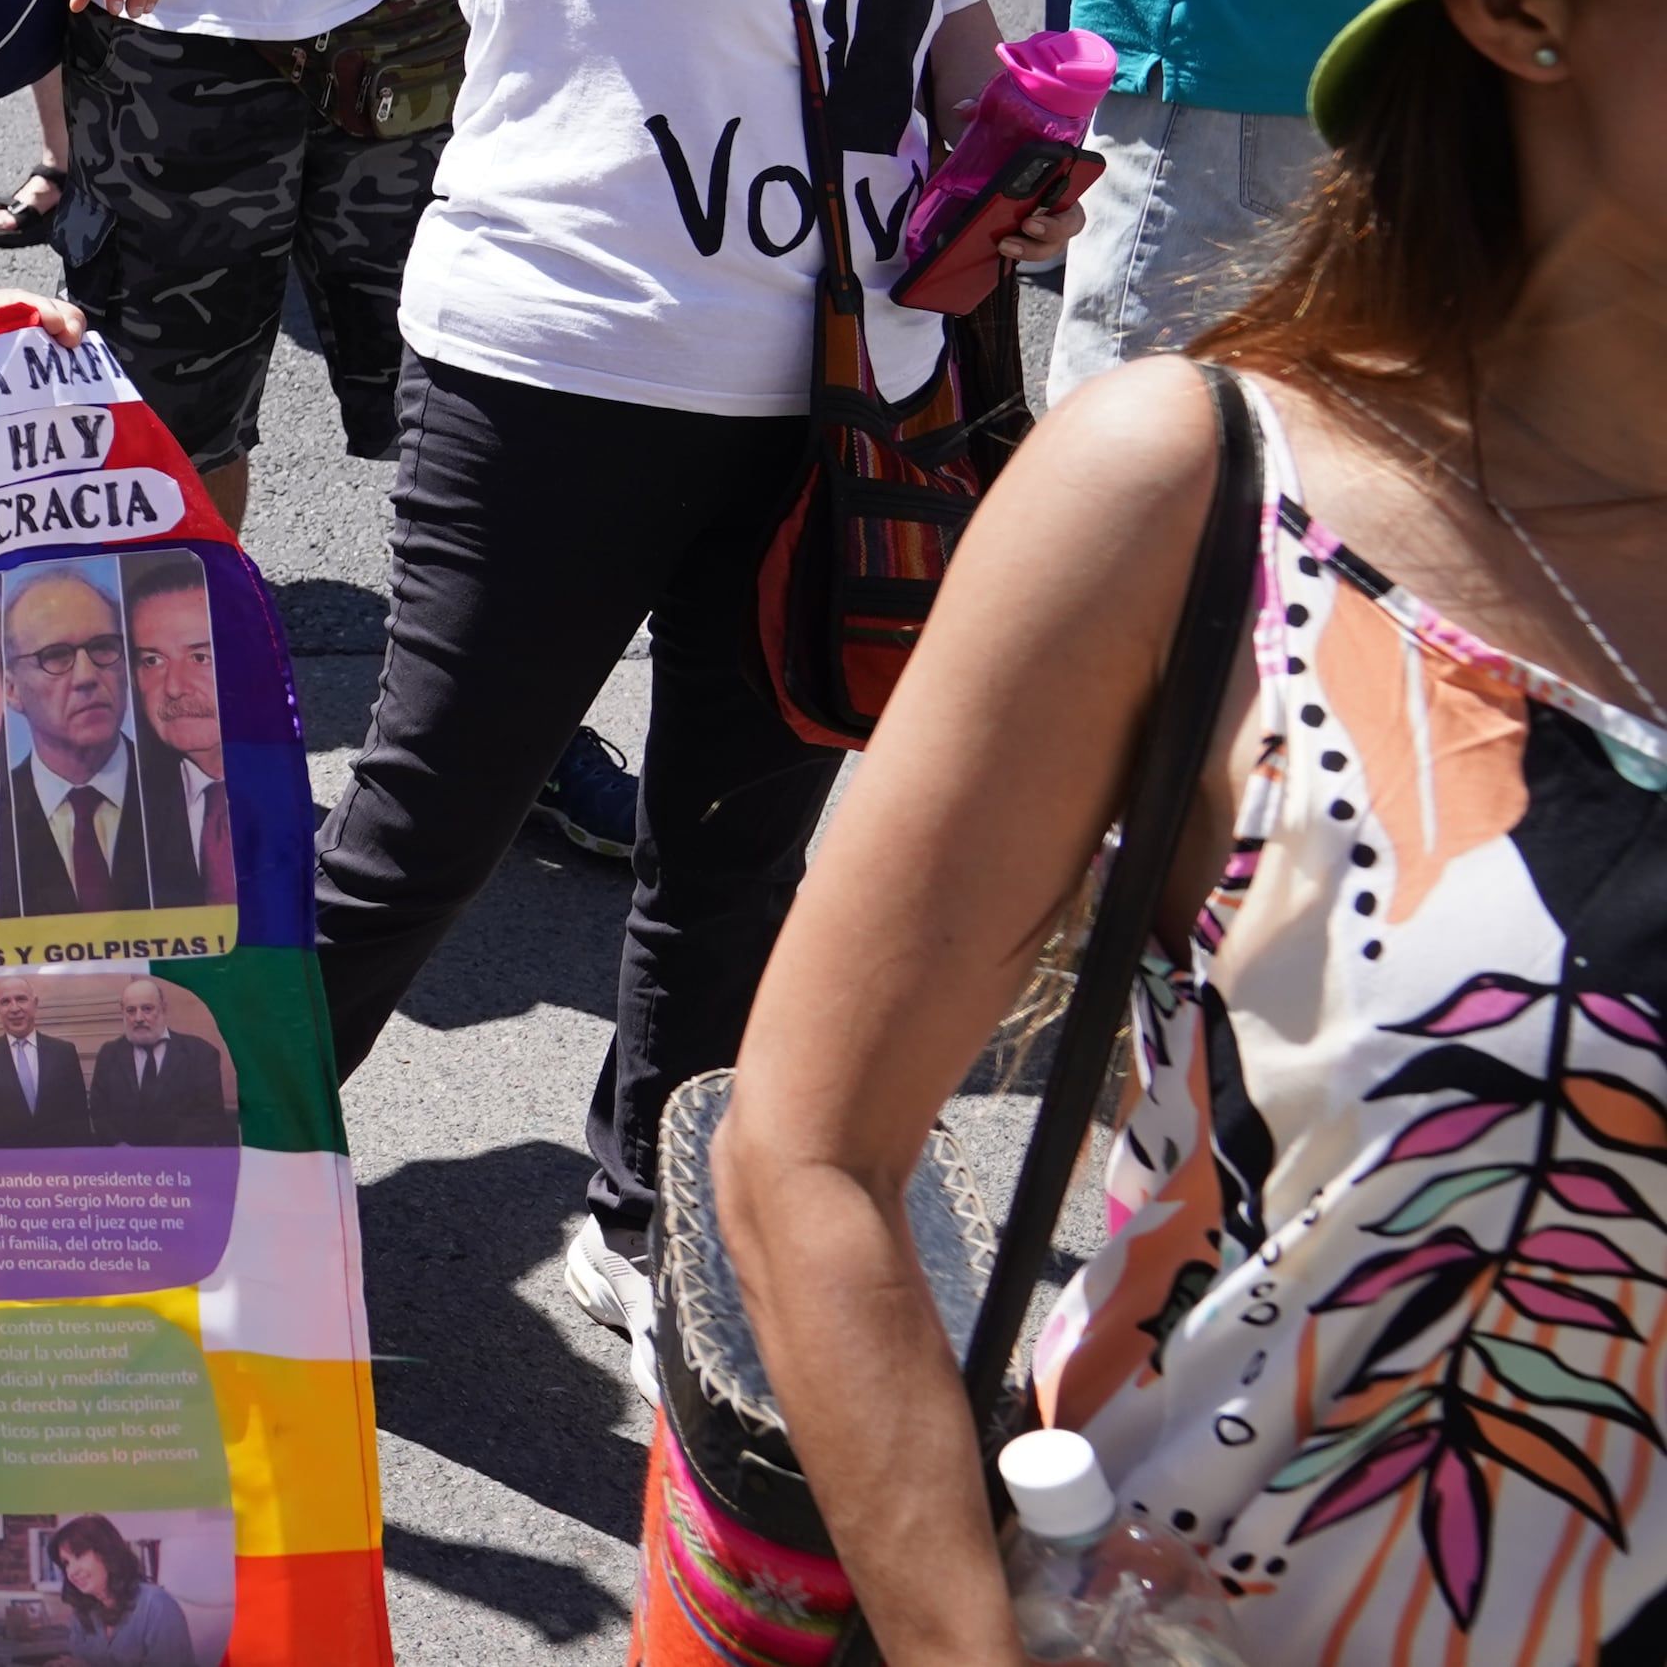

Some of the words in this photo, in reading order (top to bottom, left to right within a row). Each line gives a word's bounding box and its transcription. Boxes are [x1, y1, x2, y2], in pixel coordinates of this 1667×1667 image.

[8, 415, 107, 472] HAY
[15, 945, 33, 966] Y
[44, 935, 209, 964] GOLPISTAS
[45, 1175, 70, 1187] era
[72, 1171, 152, 1190] presidente
[155, 1171, 174, 1187] de
[177, 1171, 192, 1187] la
